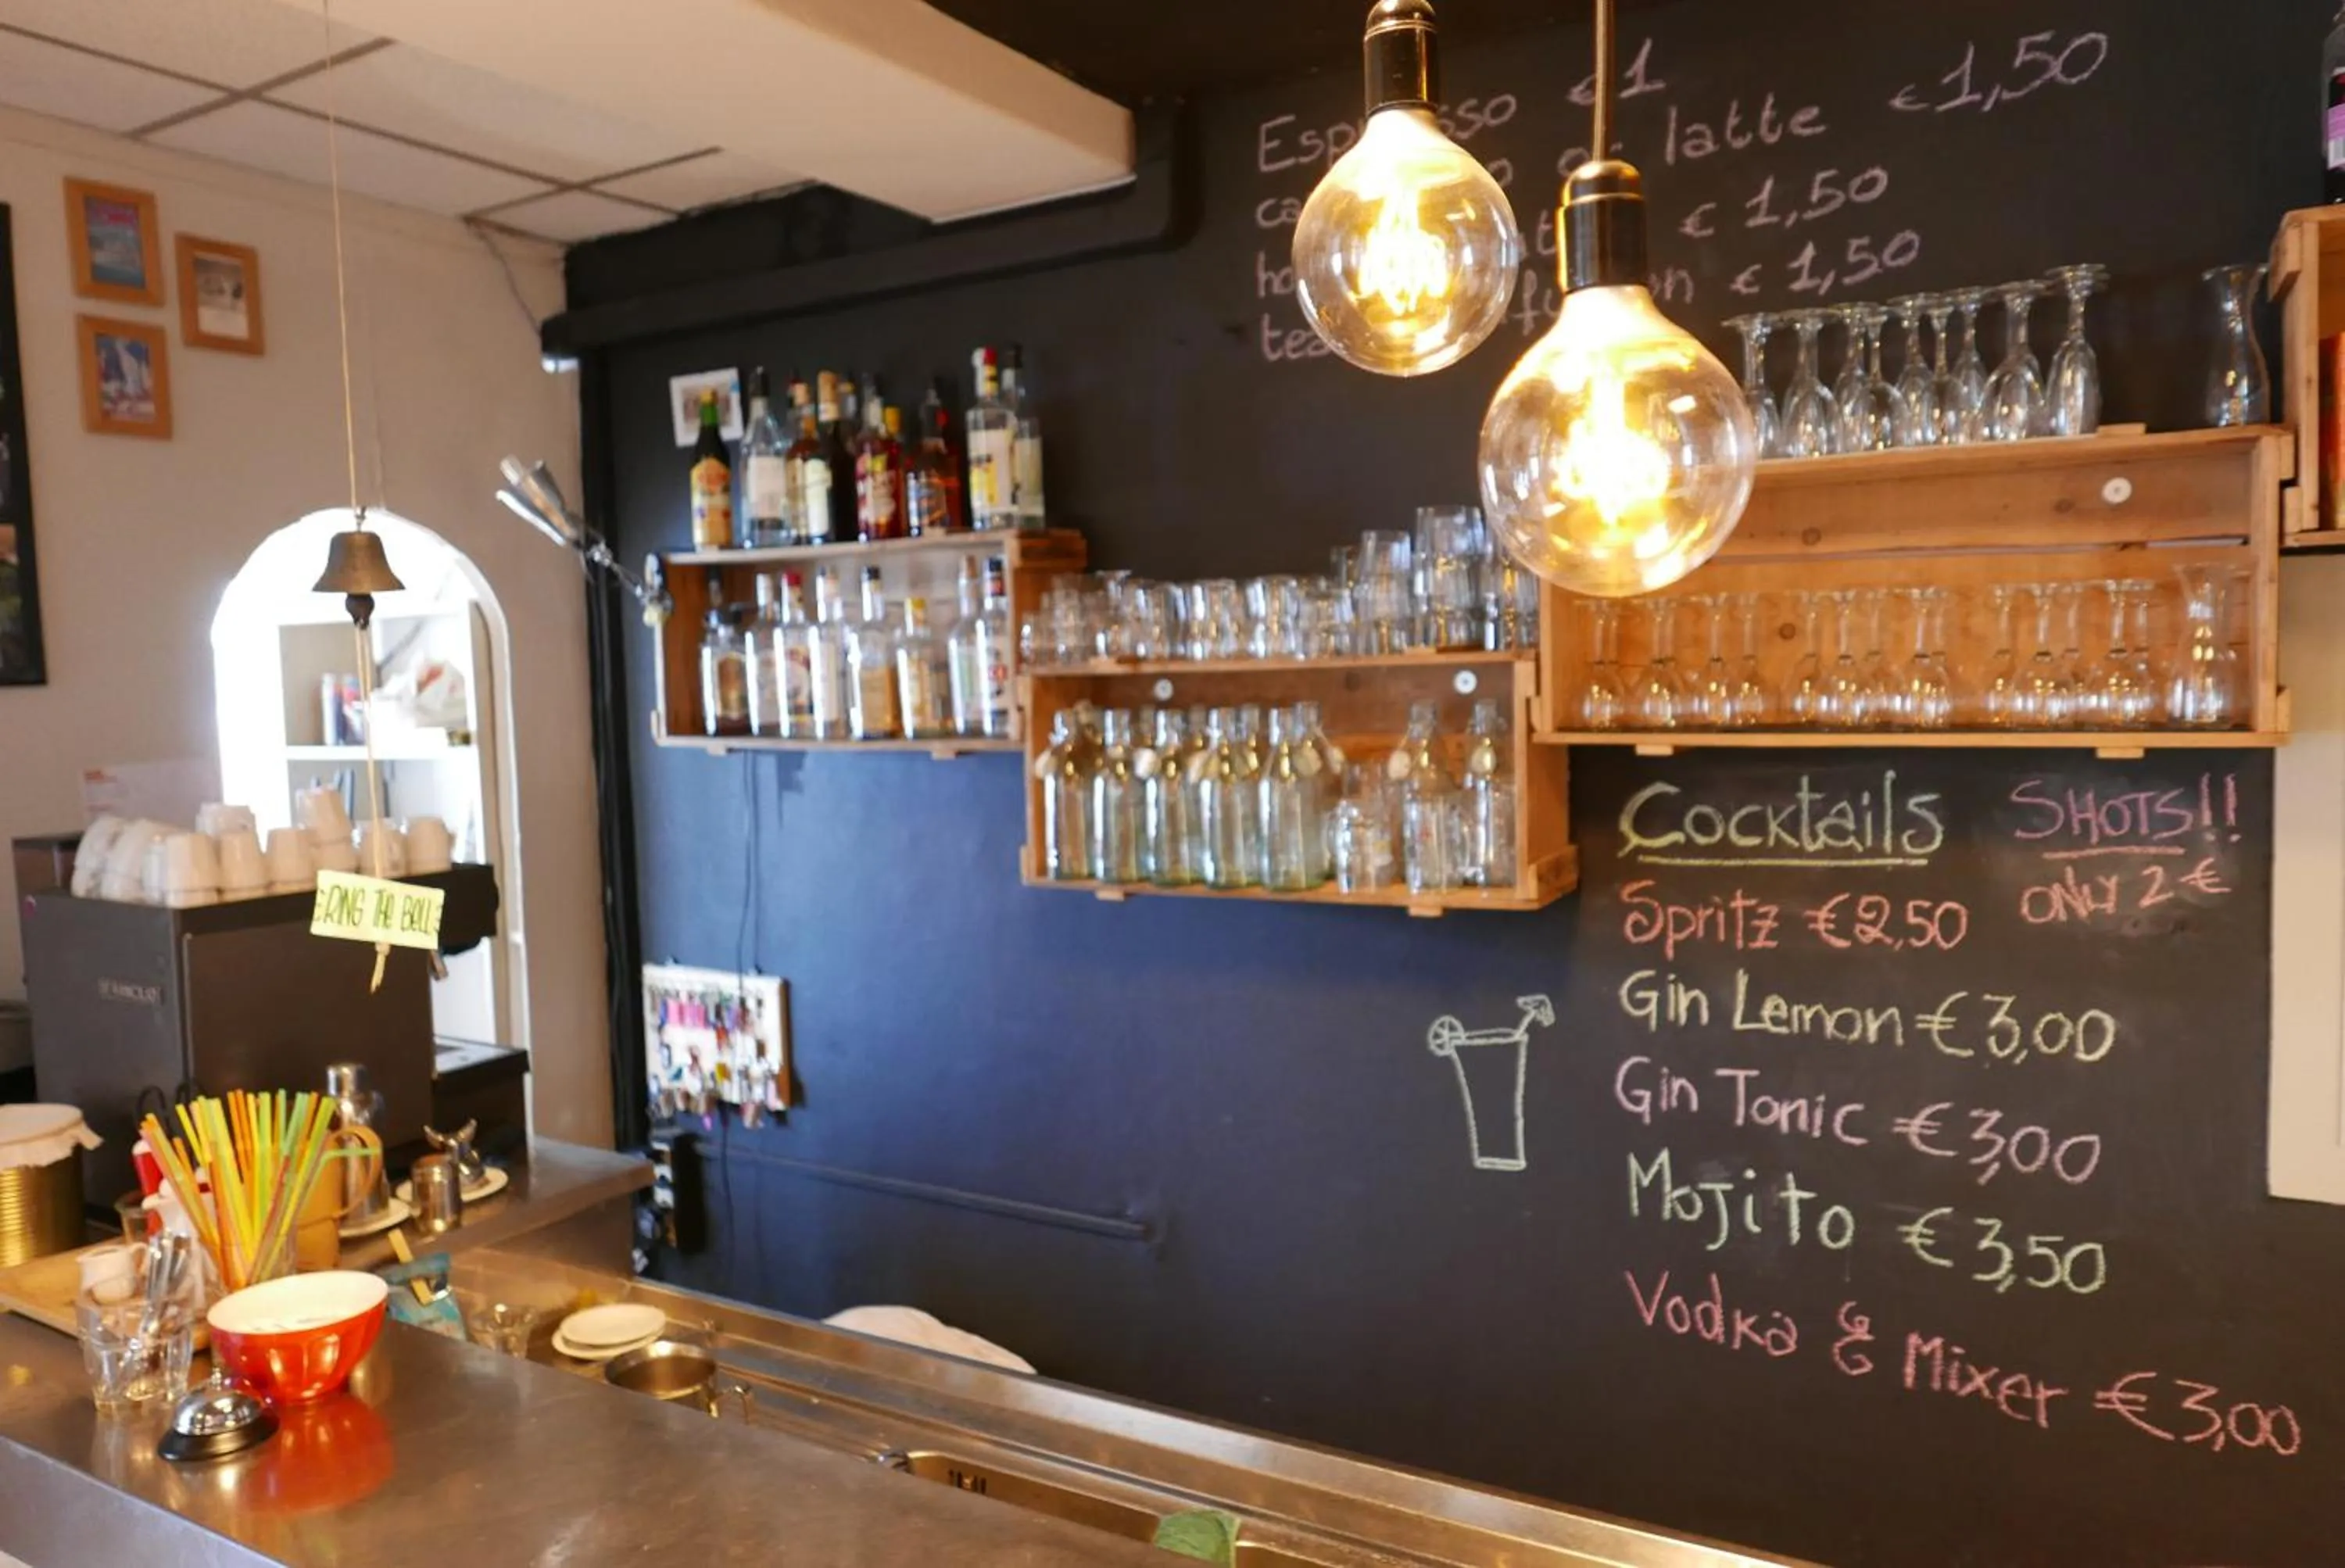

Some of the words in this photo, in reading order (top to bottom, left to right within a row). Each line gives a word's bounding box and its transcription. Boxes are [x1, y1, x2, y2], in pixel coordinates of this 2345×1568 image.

[1665, 91, 1826, 164] latte
[1617, 769, 1945, 858] Cocktails
[2010, 771, 2242, 844] SHOTS!!
[1620, 879, 1780, 961] Spritz
[1619, 970, 1710, 1032] Gin
[1732, 968, 1904, 1046] Lemon
[1615, 1056, 1699, 1126] Gin
[1715, 1068, 1869, 1144] Tonic
[1627, 1147, 1856, 1252] Mojito
[1624, 1269, 1799, 1356] Vodka
[1903, 1330, 2068, 1429] Mixer
